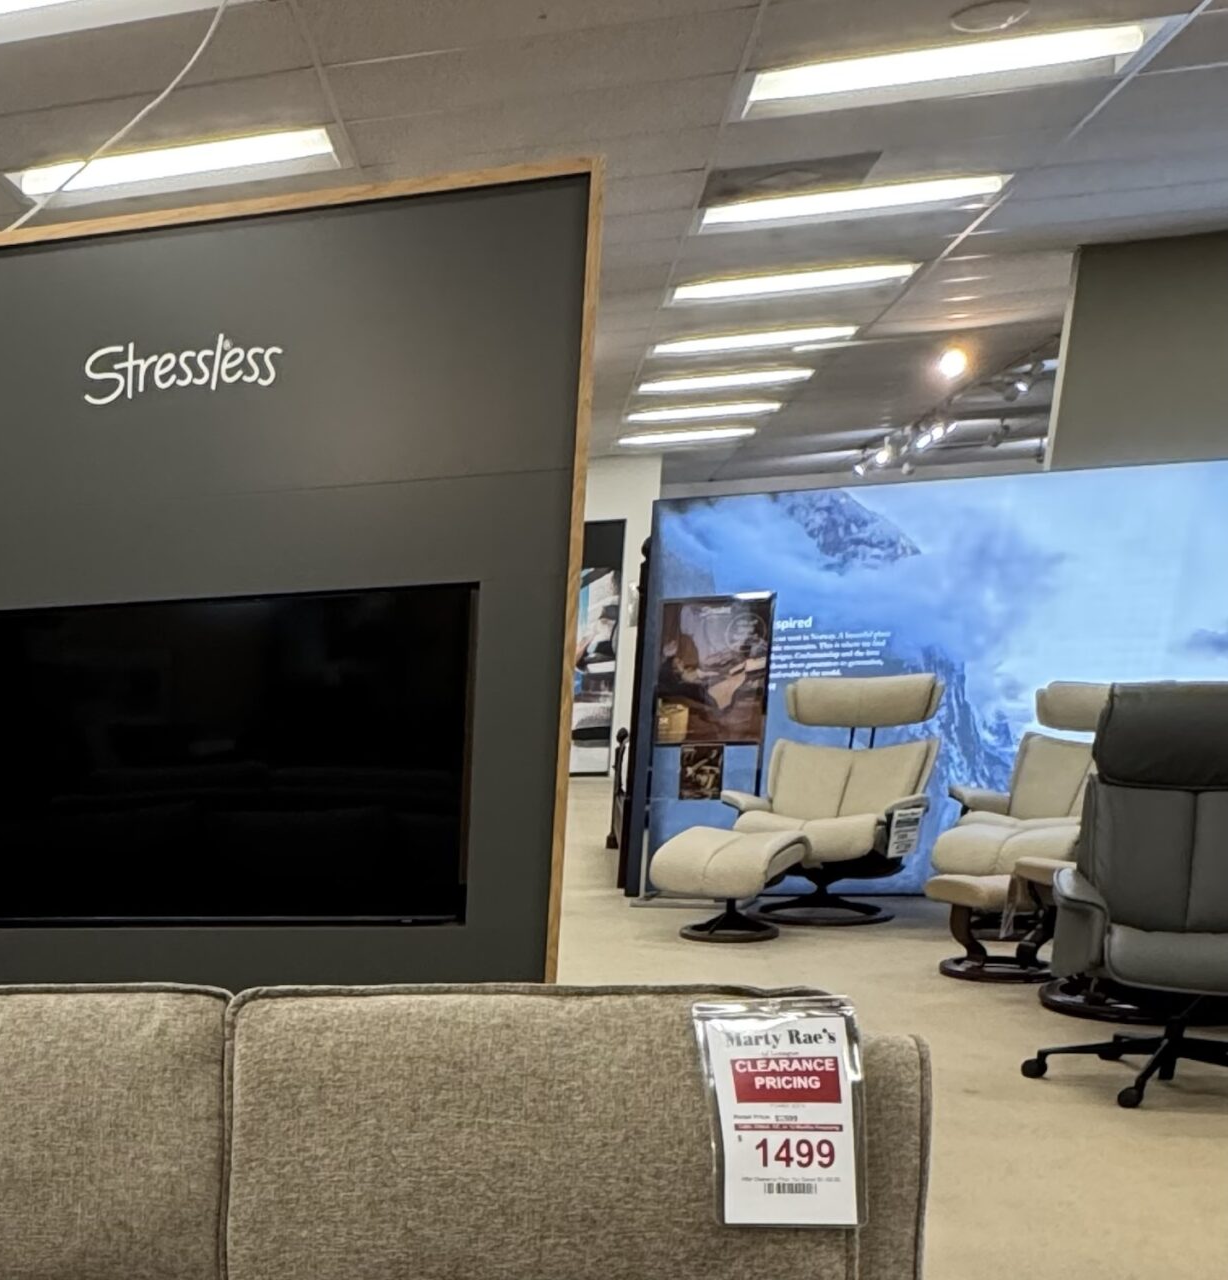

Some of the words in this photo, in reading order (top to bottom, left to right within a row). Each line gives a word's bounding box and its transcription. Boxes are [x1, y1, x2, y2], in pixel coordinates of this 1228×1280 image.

[84, 333, 283, 405] Stressless
[725, 1031, 781, 1049] Marty
[787, 1028, 836, 1045] Rae's
[735, 1058, 836, 1072] CLEARANCE
[754, 1076, 821, 1089] PRICING
[755, 1138, 836, 1168] 1499
